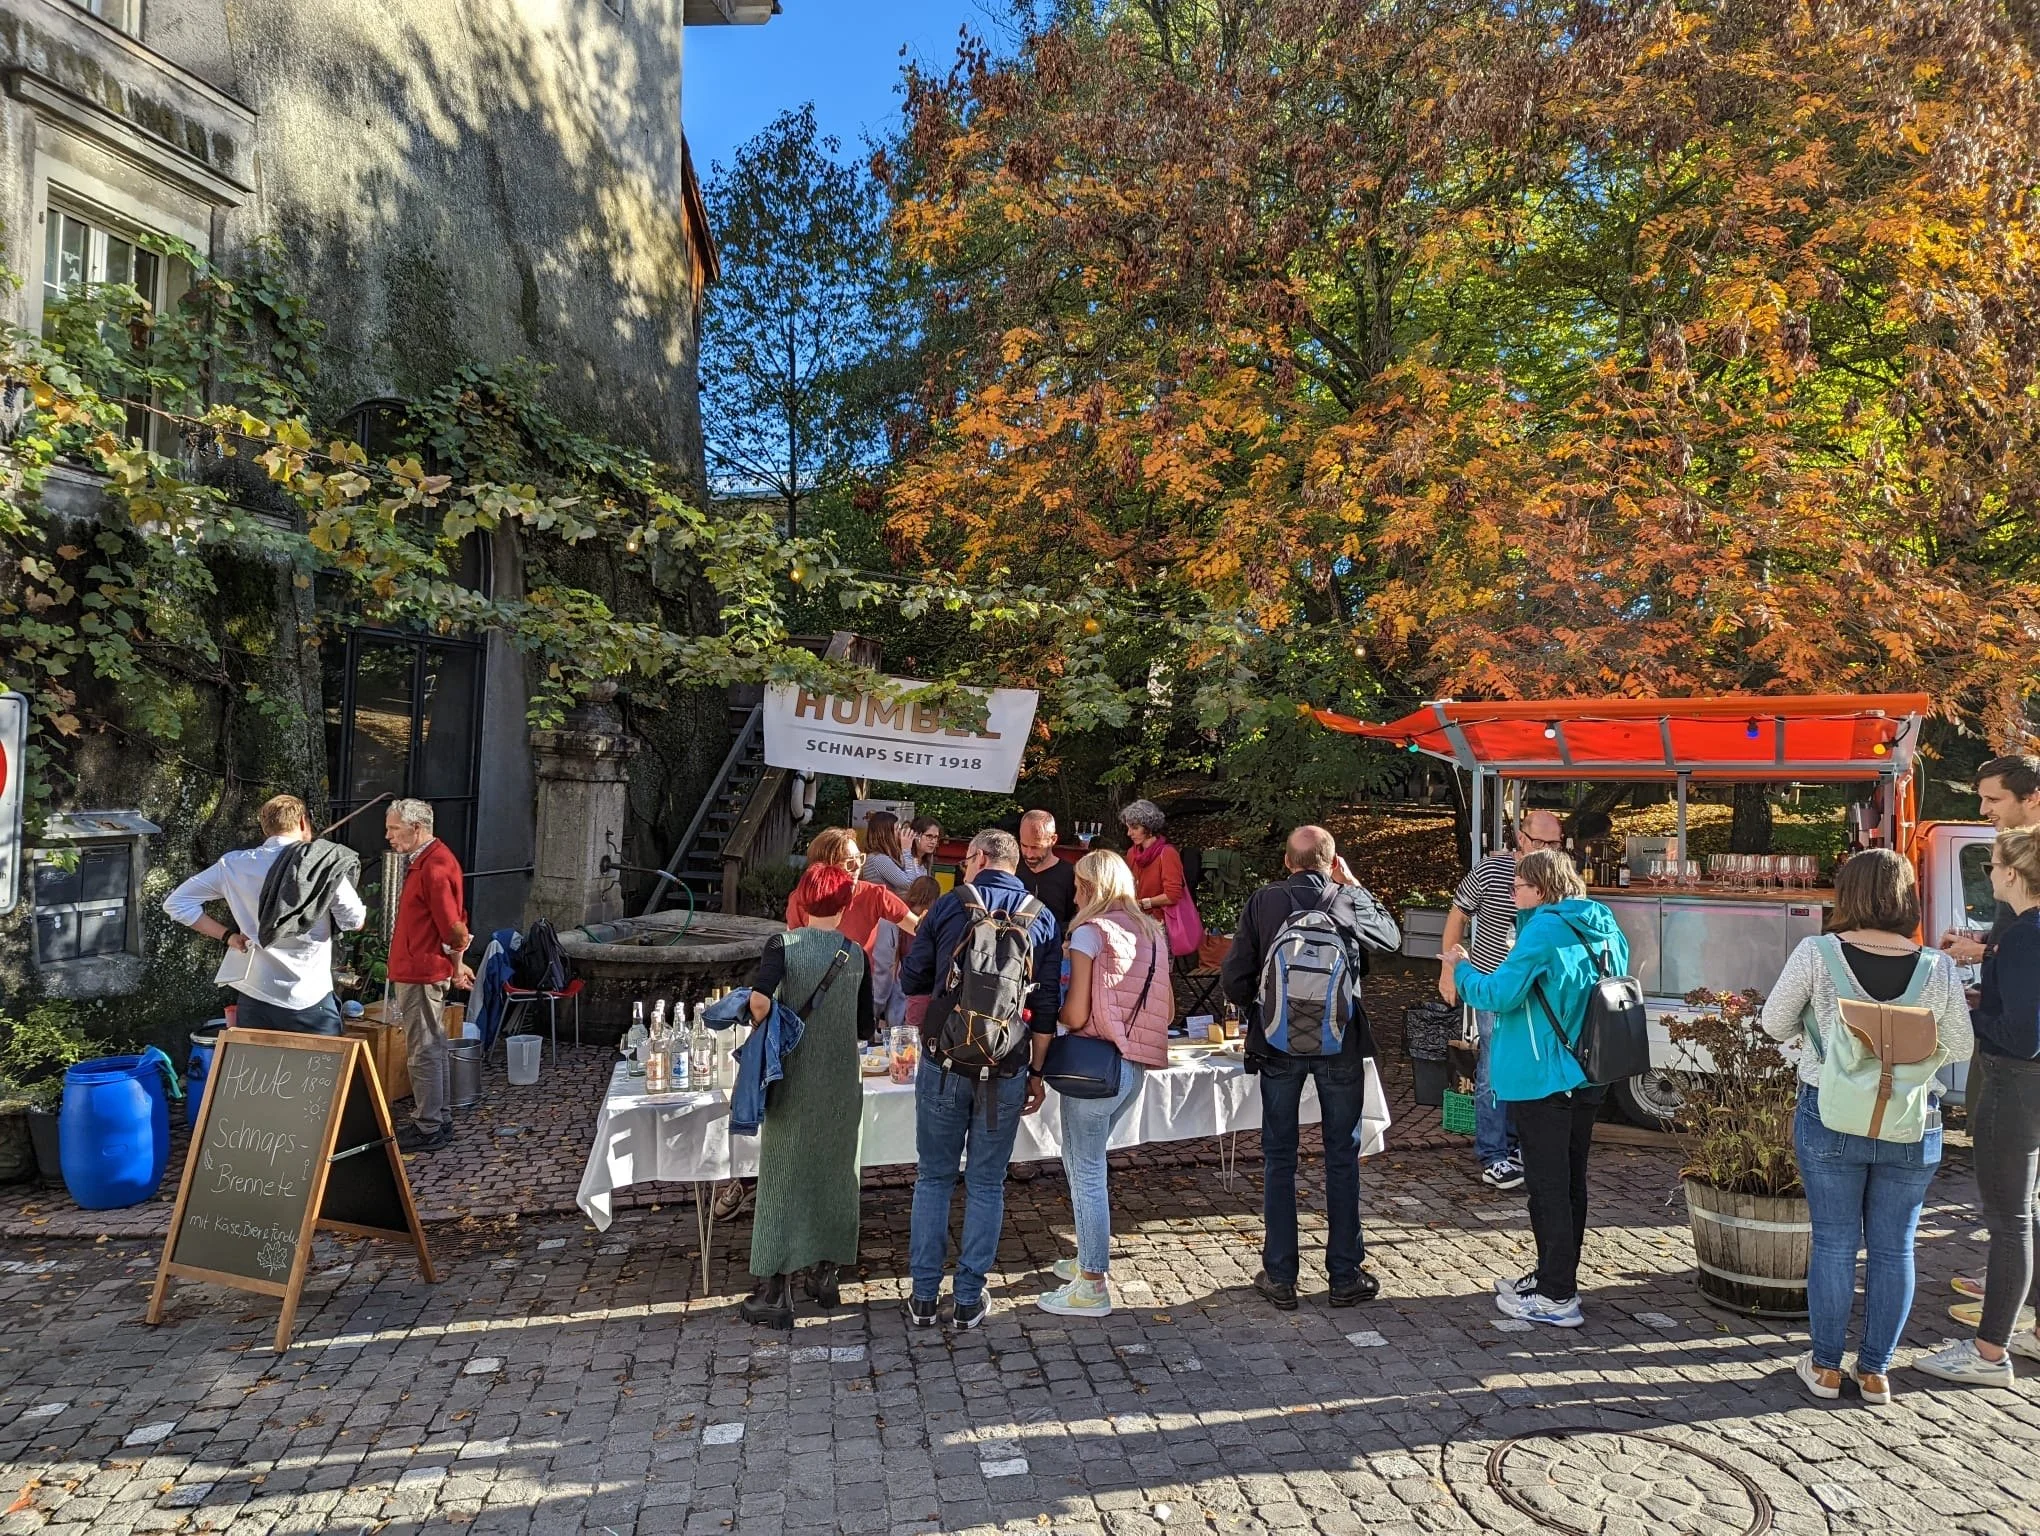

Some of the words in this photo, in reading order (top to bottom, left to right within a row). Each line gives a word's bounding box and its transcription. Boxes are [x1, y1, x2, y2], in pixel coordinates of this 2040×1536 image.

[806, 739, 887, 761] SCHNAPS
[893, 750, 934, 766] SEIT
[939, 756, 982, 770] 1918
[222, 1053, 295, 1099] Heute
[190, 1213, 208, 1230] mit
